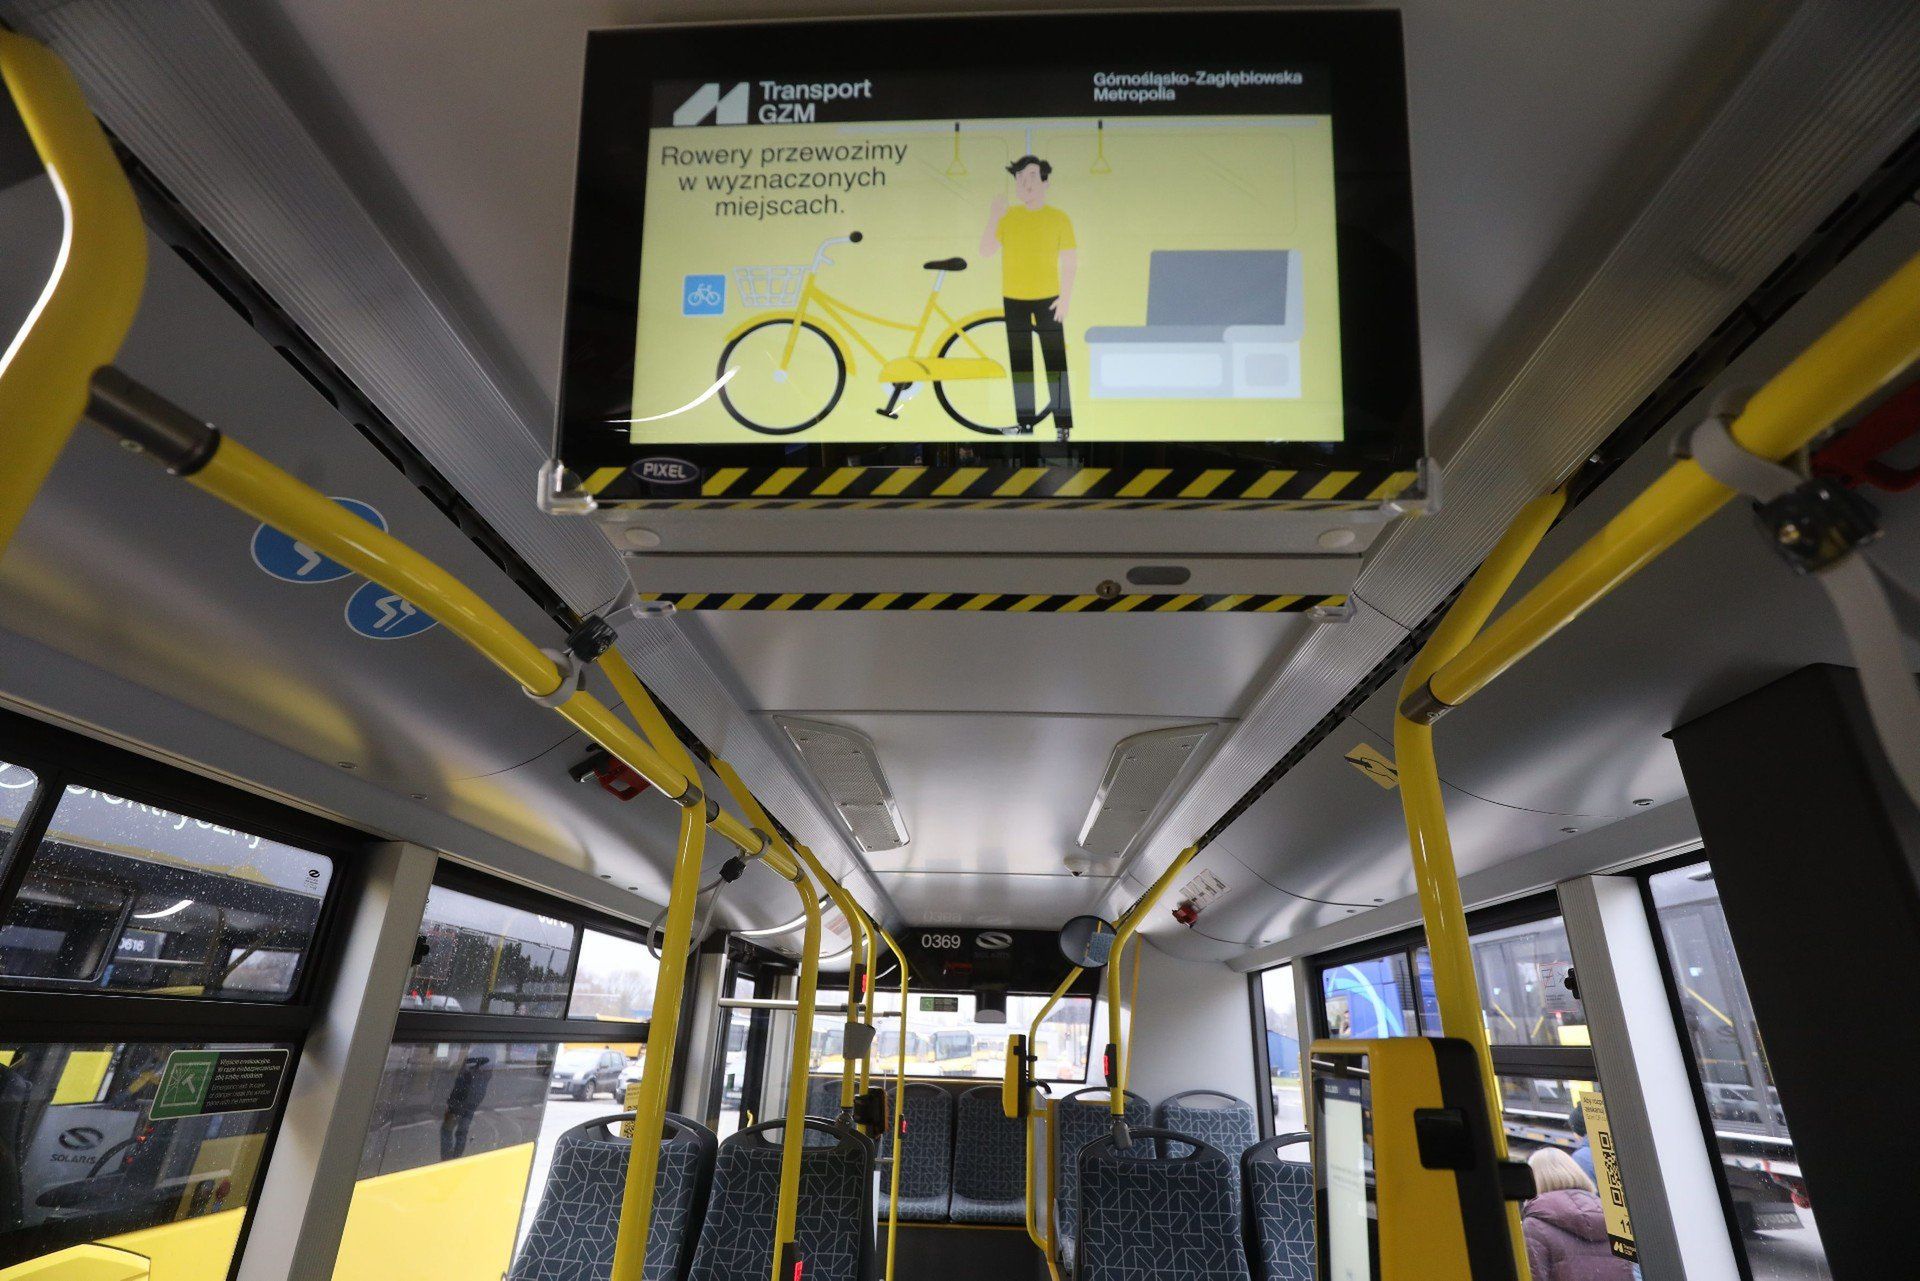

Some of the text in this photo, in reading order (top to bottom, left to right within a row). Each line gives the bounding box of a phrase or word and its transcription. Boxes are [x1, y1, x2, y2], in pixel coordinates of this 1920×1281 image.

[1093, 70, 1303, 89] Górnośląsko-Zagłębiowska
[759, 79, 873, 102] Transport
[1093, 86, 1176, 104] Metropolia
[759, 103, 816, 124] GZM
[661, 141, 908, 169] Rowery przewozimy
[679, 166, 886, 195] w wyznaczonych
[716, 194, 845, 221] miejscach.
[643, 462, 687, 479] PIXEL
[921, 933, 962, 949] 0369
[49, 1153, 97, 1165] SOLARIS
